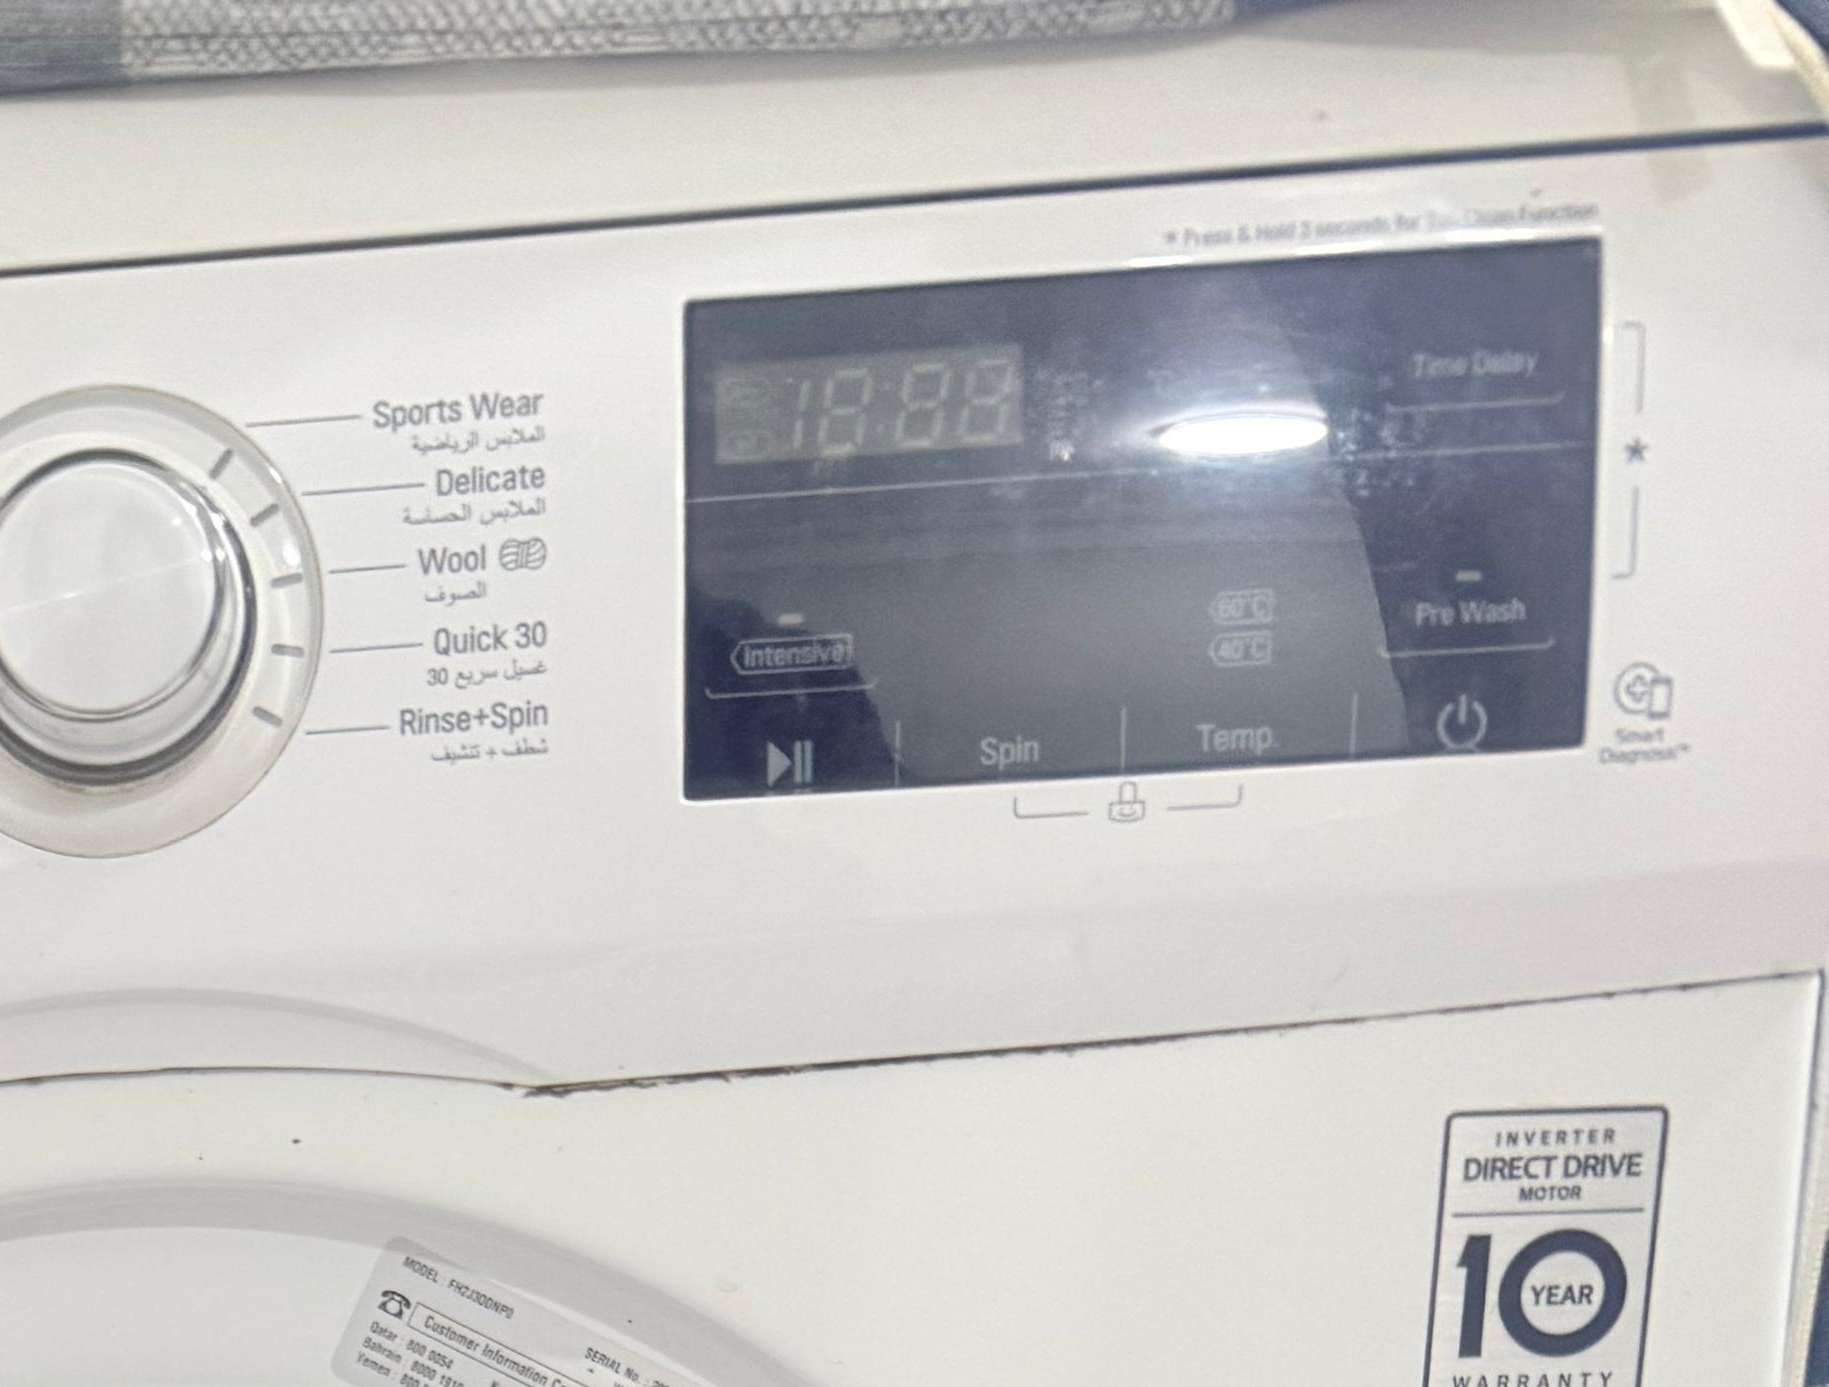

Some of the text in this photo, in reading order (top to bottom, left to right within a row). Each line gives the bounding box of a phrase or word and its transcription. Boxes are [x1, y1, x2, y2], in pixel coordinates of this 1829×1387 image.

[373, 392, 544, 433] Sports Wear
[412, 425, 546, 455] الملابس الرياضية
[436, 465, 545, 496] Delicate
[480, 498, 546, 525] الملابس
[418, 544, 487, 576] Wool
[425, 580, 487, 607] الصوف
[1415, 598, 1527, 627] Pre Wash
[434, 621, 548, 657] Quick 30
[743, 640, 845, 668] Intensive
[427, 658, 548, 690] غسيل سريع 30
[399, 700, 548, 736] Rinse+Spin
[979, 735, 1041, 771] Spin
[1495, 1128, 1616, 1147] INVERTER
[1462, 1152, 1643, 1182] DIRECT DRIVE
[1518, 1186, 1583, 1202] MOTOR
[402, 1256, 440, 1284] MODEL
[1455, 1227, 1628, 1359] 10
[1530, 1283, 1594, 1306] YEAR
[424, 1315, 480, 1351] Customer
[482, 1343, 549, 1387] Information
[584, 1347, 621, 1374] SERIAL
